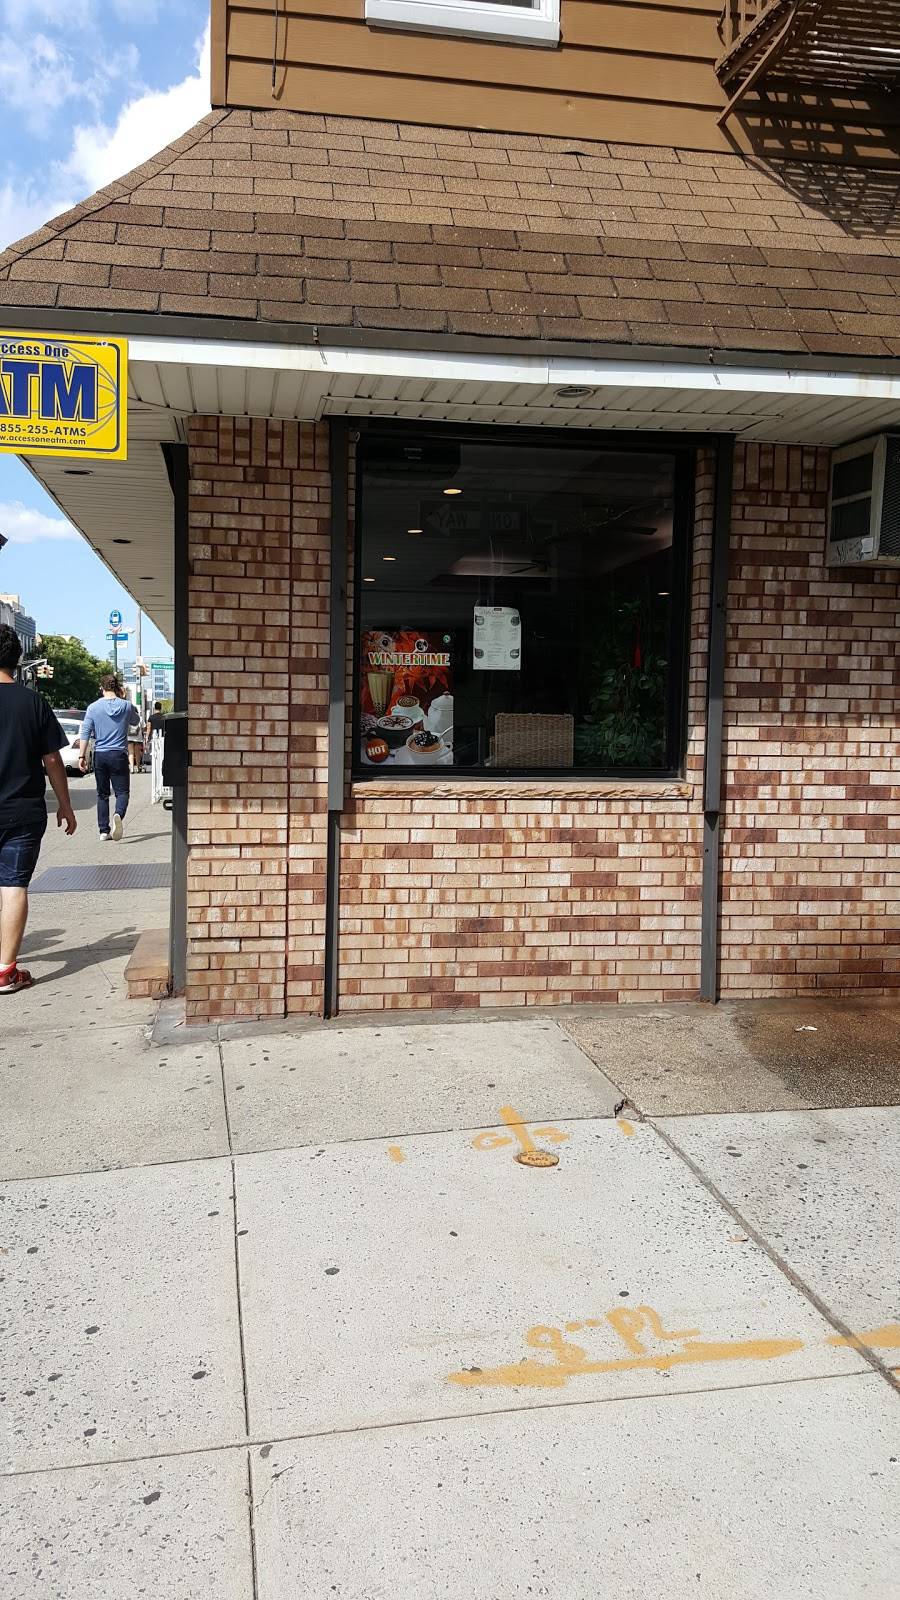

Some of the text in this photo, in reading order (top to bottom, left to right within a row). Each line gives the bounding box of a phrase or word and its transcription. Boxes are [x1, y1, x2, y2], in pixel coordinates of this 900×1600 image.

[44, 345, 69, 358] One
[368, 652, 450, 666] WINTERTIME
[367, 744, 386, 756] HOT
